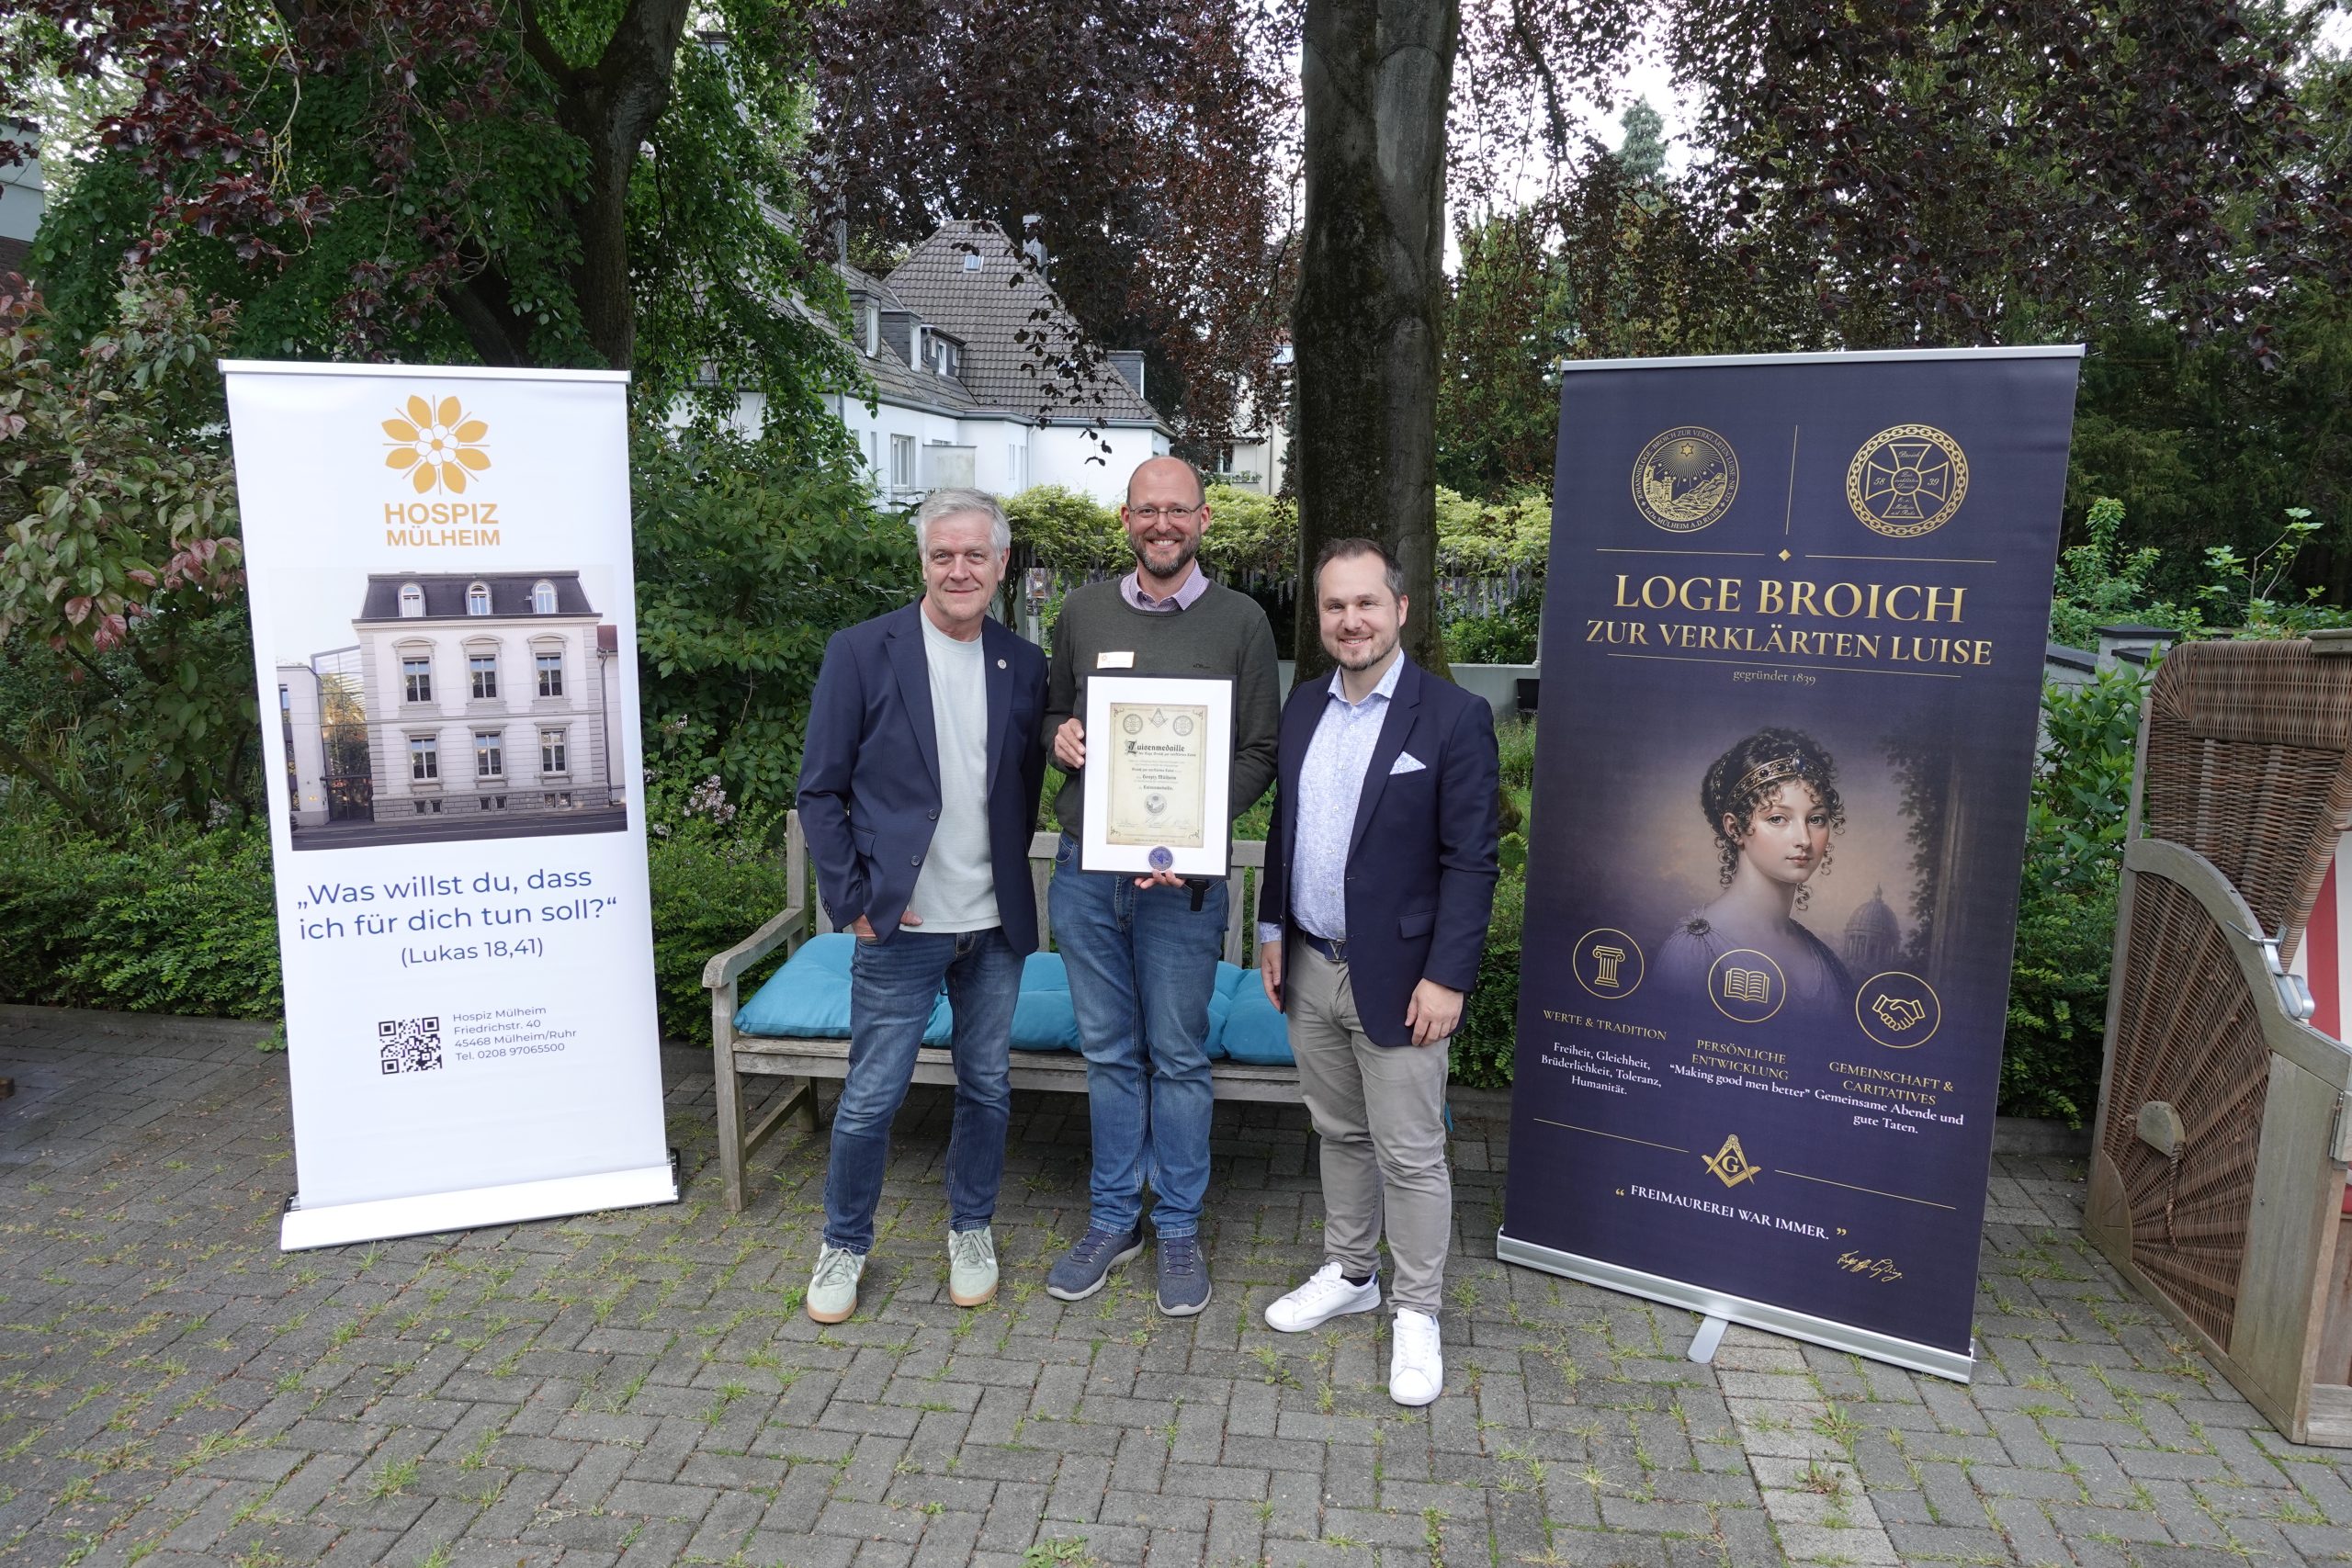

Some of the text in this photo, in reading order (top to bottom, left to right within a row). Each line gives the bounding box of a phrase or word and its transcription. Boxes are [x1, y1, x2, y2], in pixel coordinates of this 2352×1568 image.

[384, 502, 499, 526] HOSPIZ
[1657, 517, 1689, 529] MÜLHEIM
[386, 525, 501, 547] MÜLHEIM
[1613, 574, 1968, 623] LOGE BROICH
[1586, 619, 1993, 666] ZUR VERKLÄRTEN LUISE
[1733, 670, 1816, 686] gegründet 1839
[297, 868, 593, 910] „Was willst du, dass
[300, 896, 618, 941] ich für dich tun soll?“
[401, 937, 544, 968] (Lukas 18,41)
[453, 1007, 547, 1021] Hospiz Mülheim
[1544, 1010, 1667, 1041] WERTE & TRADITION
[454, 1020, 541, 1035] Friedrichstr. 40
[455, 1030, 577, 1047] 45468 Mülheim/Ruhr
[456, 1043, 565, 1061] Tel. 0208 97065500
[1554, 1042, 1651, 1070] Freiheit, Gleichheit,
[1697, 1039, 1786, 1065] PERSÖNLICHE
[1541, 1054, 1662, 1088] Brüderlichkeit, Toleranz,
[1691, 1054, 1789, 1080] ENTWICKLUNG
[1828, 1061, 1954, 1092] GEMEINSCHAFT &
[1571, 1075, 1628, 1095] Humanität.
[1669, 1064, 1810, 1098] “Making good men better”
[1843, 1080, 1937, 1105] CARITATIVES
[1815, 1089, 1964, 1125] Gemeinsame Abende und
[1853, 1114, 1918, 1134] gute Taten.
[1721, 1155, 1740, 1173] G
[1631, 1184, 1735, 1218] FREIMAUREREI
[1738, 1209, 1771, 1226] WAR
[1775, 1217, 1829, 1240] IMMER.
